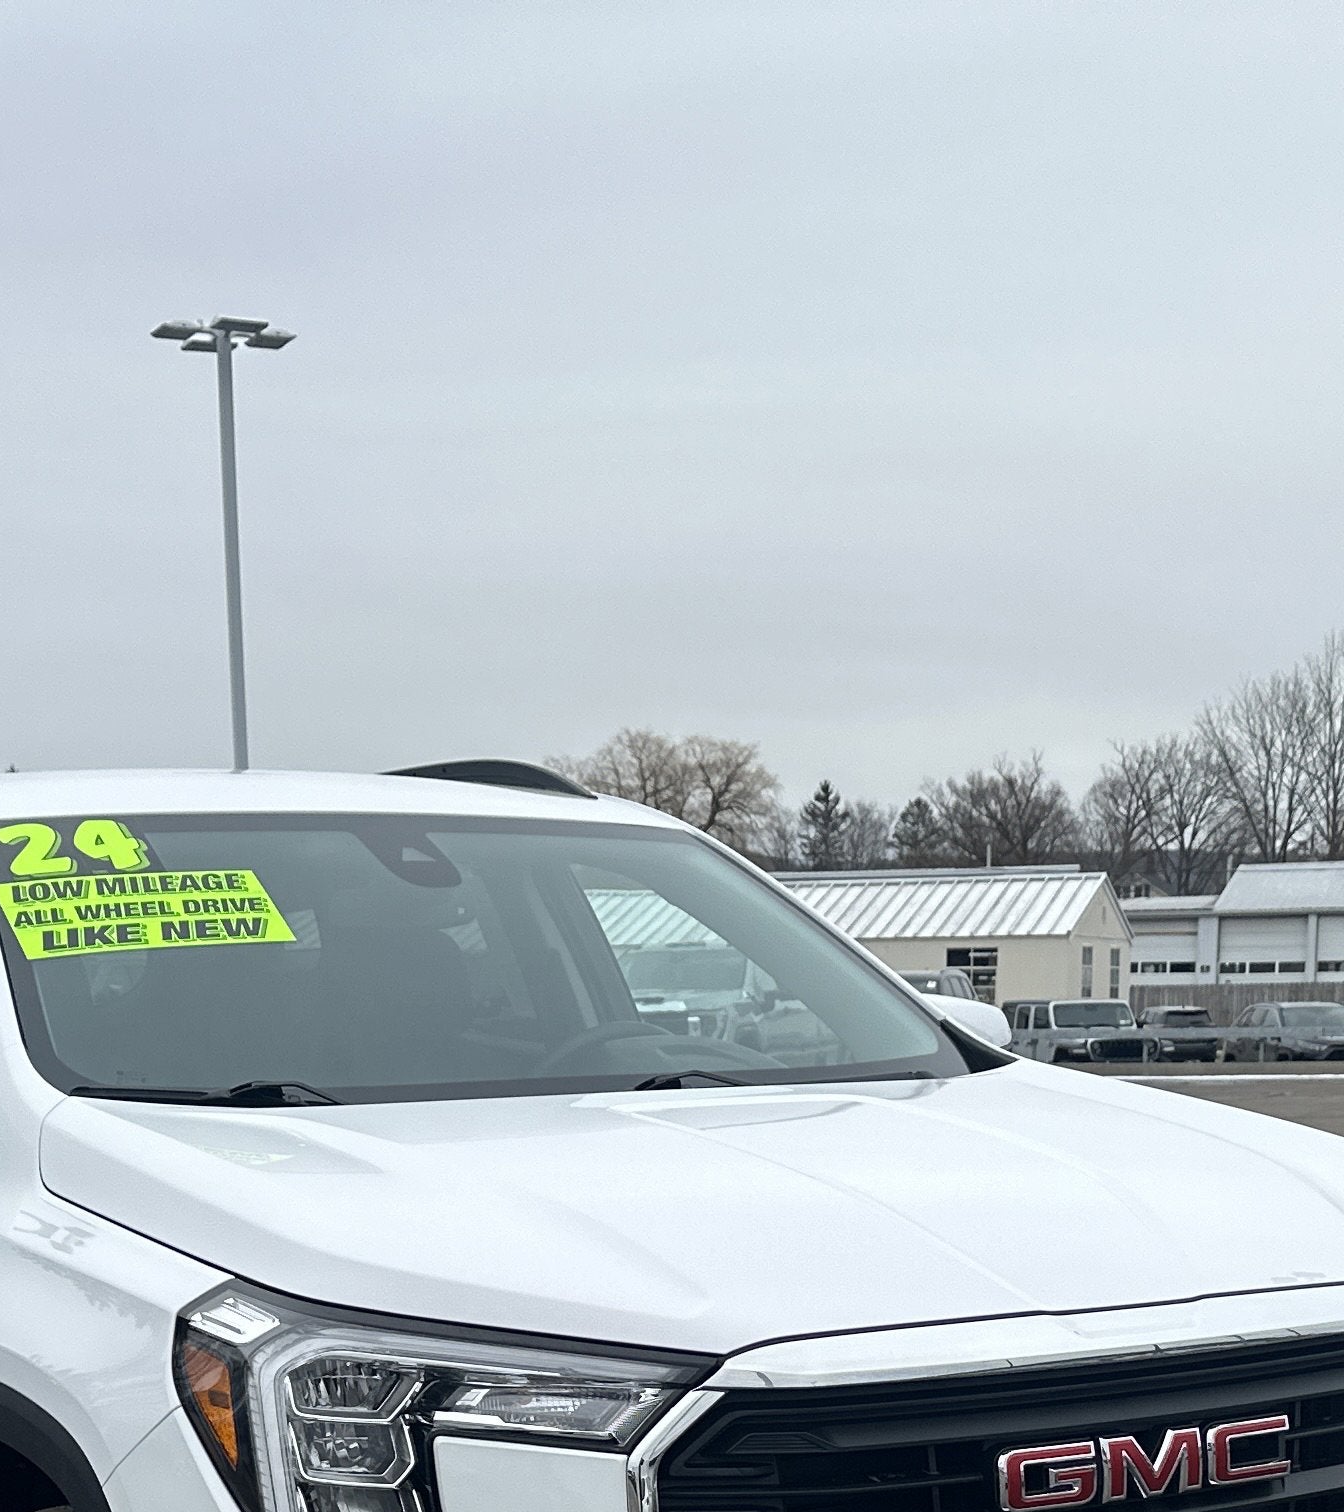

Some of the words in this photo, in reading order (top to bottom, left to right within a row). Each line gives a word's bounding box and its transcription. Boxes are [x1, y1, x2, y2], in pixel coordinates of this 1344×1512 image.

[11, 878, 89, 904] LOW
[96, 873, 249, 896] MILEAGE
[14, 907, 72, 928] ALL
[74, 900, 180, 922] WHEEL
[182, 896, 270, 916] DRIVE
[42, 922, 149, 953] LIKE
[160, 916, 270, 942] NEW
[997, 1414, 1291, 1512] GMC
